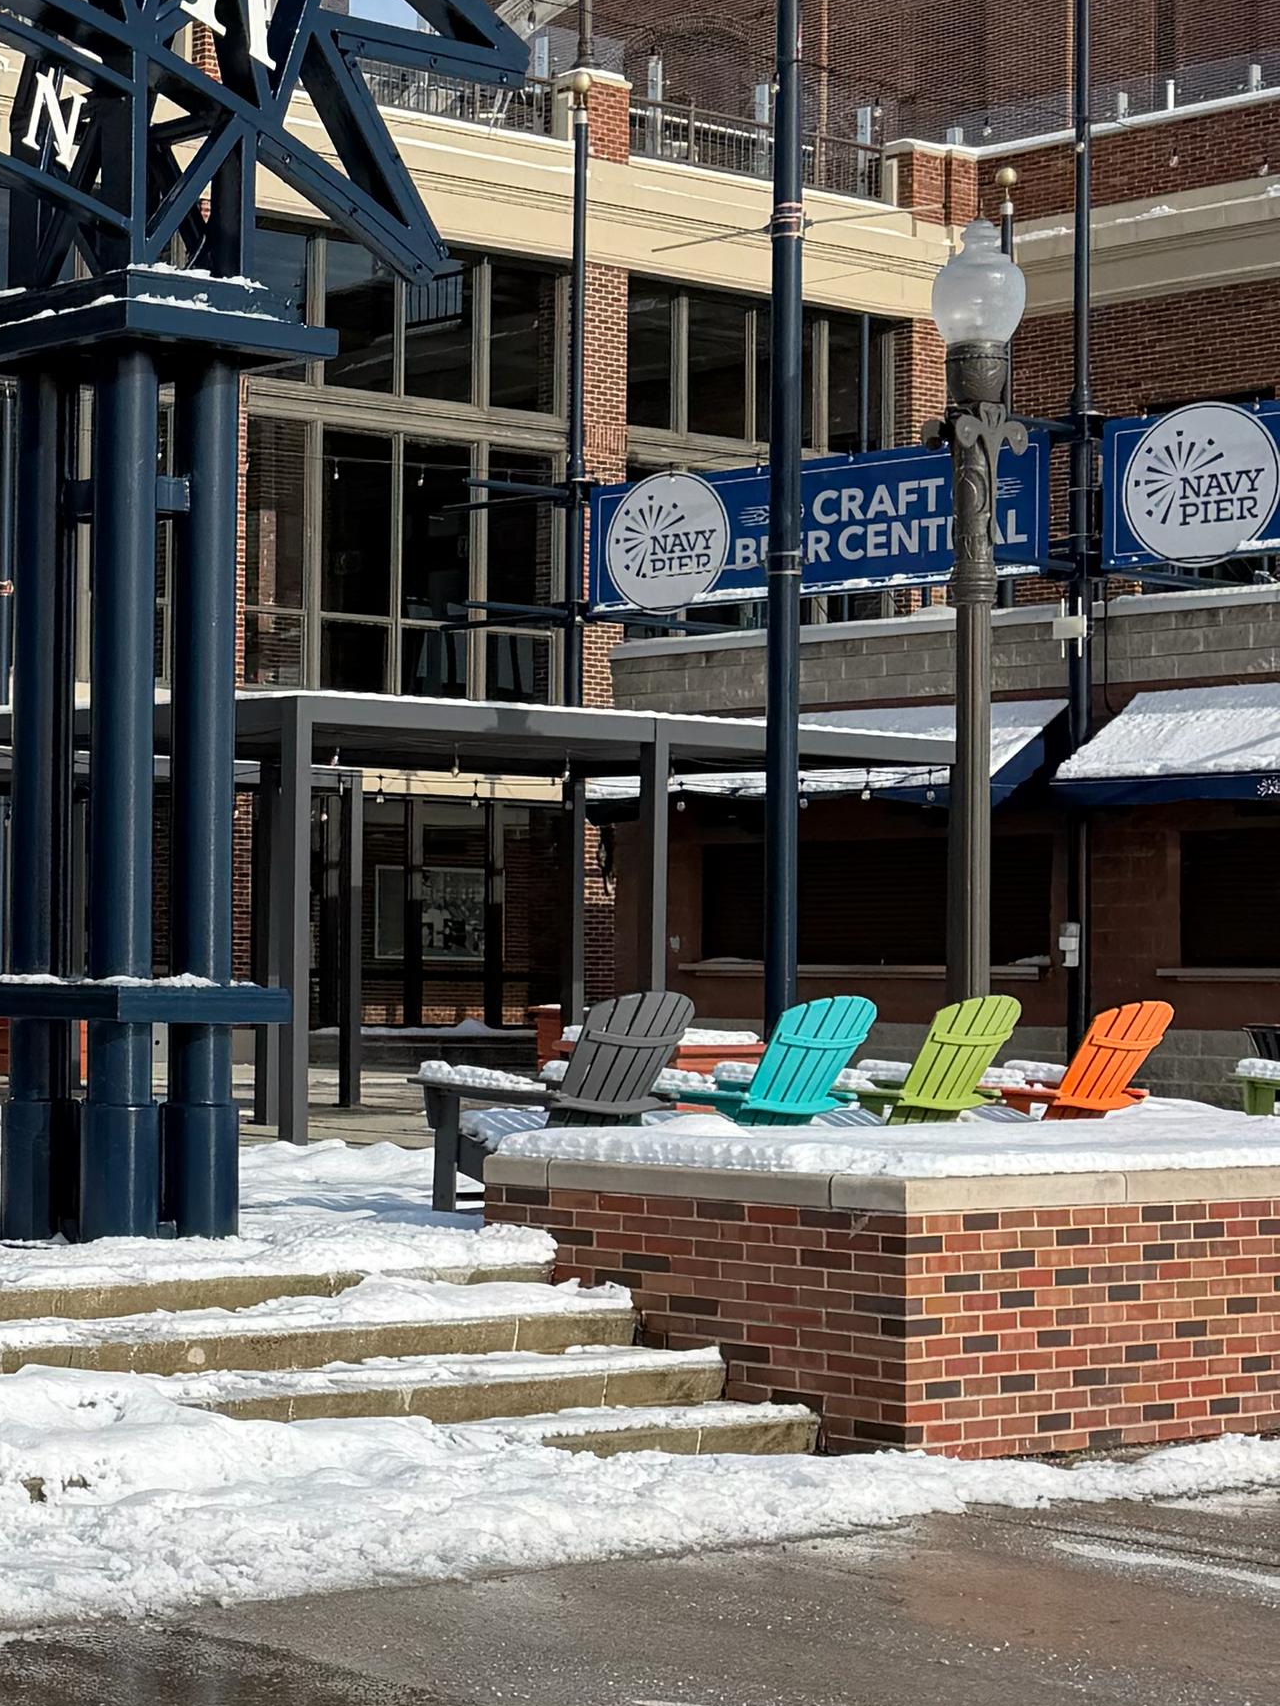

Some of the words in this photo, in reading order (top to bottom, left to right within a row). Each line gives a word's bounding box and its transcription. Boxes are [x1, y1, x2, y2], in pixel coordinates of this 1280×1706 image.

[1179, 468, 1265, 500] NAVY
[813, 477, 945, 525] CRAFT
[1179, 496, 1258, 526] PIER
[650, 529, 717, 555] NAVY
[735, 530, 831, 567] BR
[838, 509, 1028, 560] CENTL
[650, 553, 713, 578] PIER
